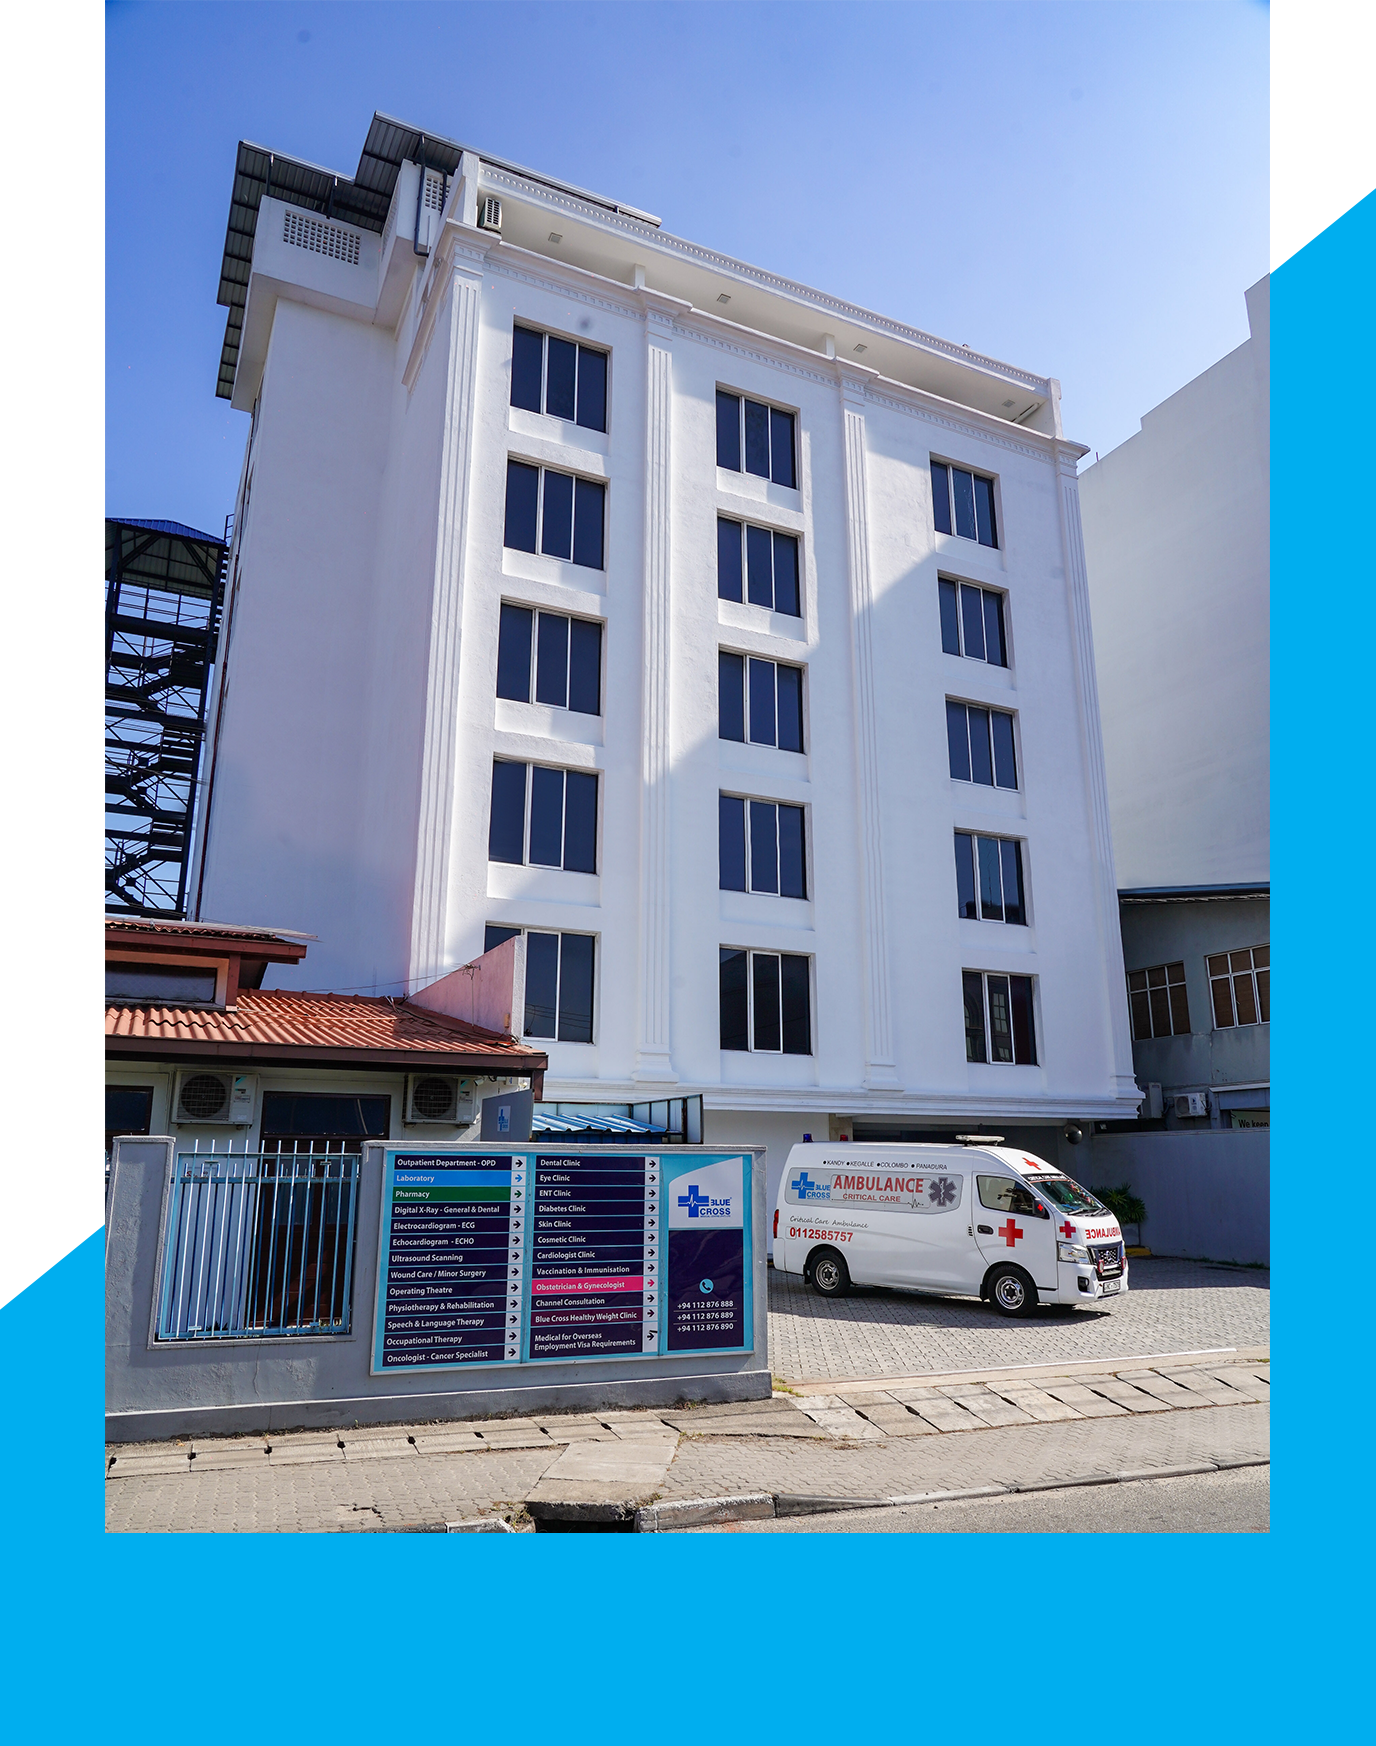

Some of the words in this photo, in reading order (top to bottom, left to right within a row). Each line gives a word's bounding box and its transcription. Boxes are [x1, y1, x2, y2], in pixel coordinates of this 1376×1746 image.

[1238, 1119, 1250, 1128] We
[398, 1159, 434, 1167] Outpatient
[436, 1159, 476, 1167] Department
[833, 1175, 923, 1193] AMBULANCE
[843, 1193, 877, 1202] CRITICAL
[832, 1220, 868, 1228] Ambulance
[790, 1227, 853, 1242] 0112585757
[537, 1251, 576, 1259] Cardiologist
[584, 1281, 625, 1290] Gynecologist
[390, 1287, 425, 1296] Operating
[389, 1304, 438, 1312] Physiotherapy
[447, 1302, 494, 1310] Rehabilitation
[536, 1299, 563, 1307] Channel
[565, 1297, 605, 1306] Consultation
[570, 1314, 595, 1323] Healthy
[596, 1313, 619, 1321] Weight
[388, 1320, 413, 1329] Speech
[421, 1319, 455, 1328] Language
[457, 1318, 484, 1327] Therapy
[387, 1337, 433, 1346] Occupational
[434, 1336, 462, 1344] Therapy
[535, 1333, 560, 1341] Medical
[535, 1342, 576, 1352] Employment
[592, 1339, 636, 1348] Requirements
[387, 1354, 425, 1363] Oncologist
[456, 1351, 488, 1360] Specialist
